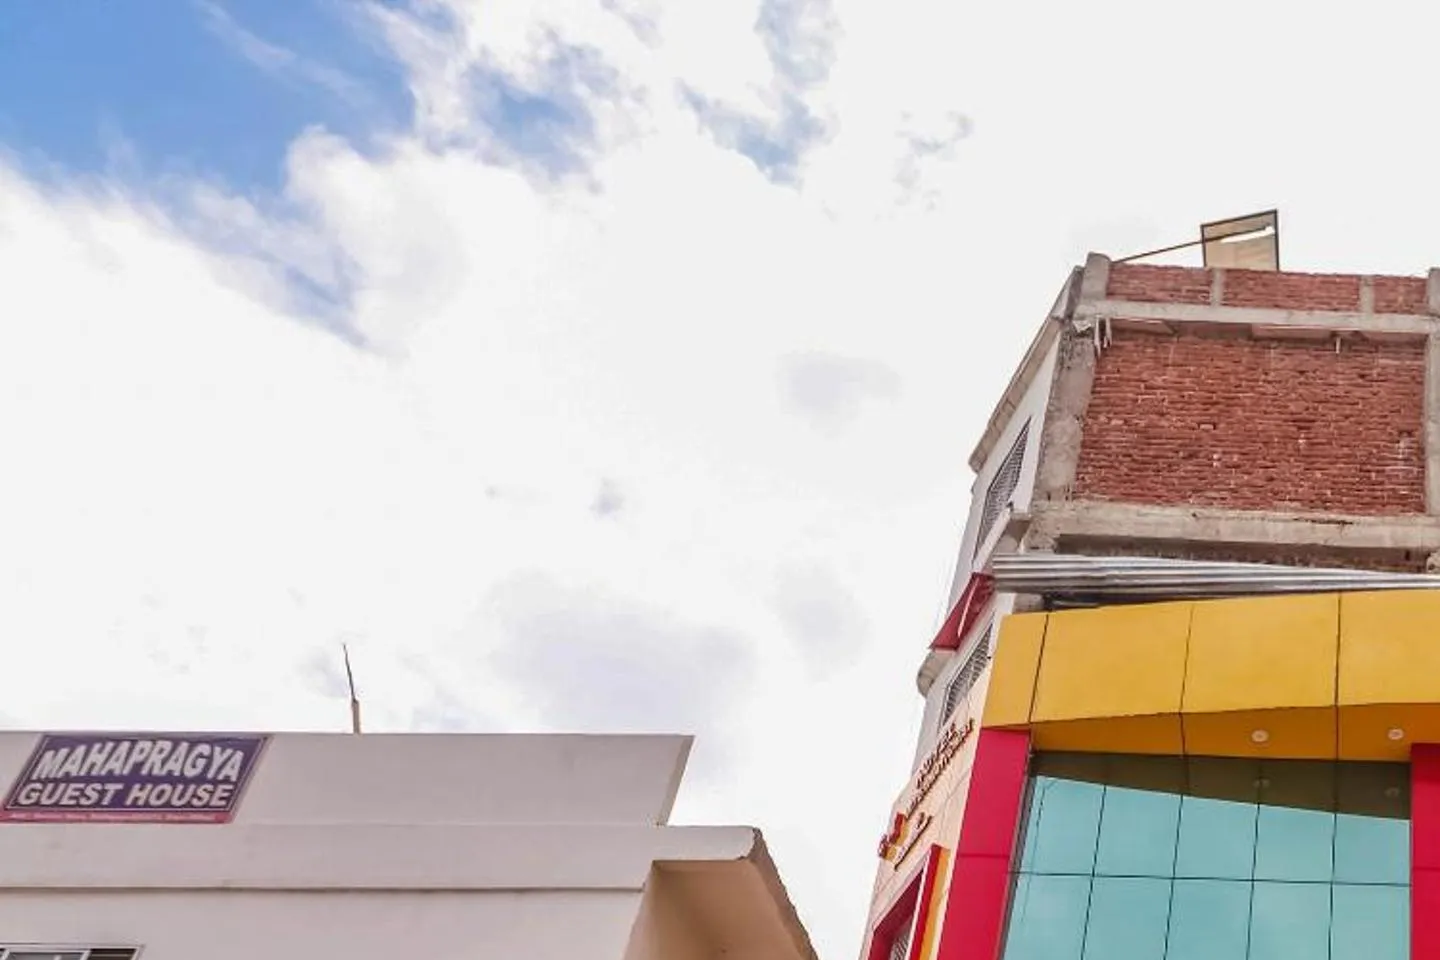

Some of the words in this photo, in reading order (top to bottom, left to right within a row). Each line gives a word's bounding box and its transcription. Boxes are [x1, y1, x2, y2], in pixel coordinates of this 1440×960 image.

[30, 739, 245, 783] MAHAPRAGYA
[17, 782, 124, 807] GUEST
[125, 783, 235, 808] HOUSE
